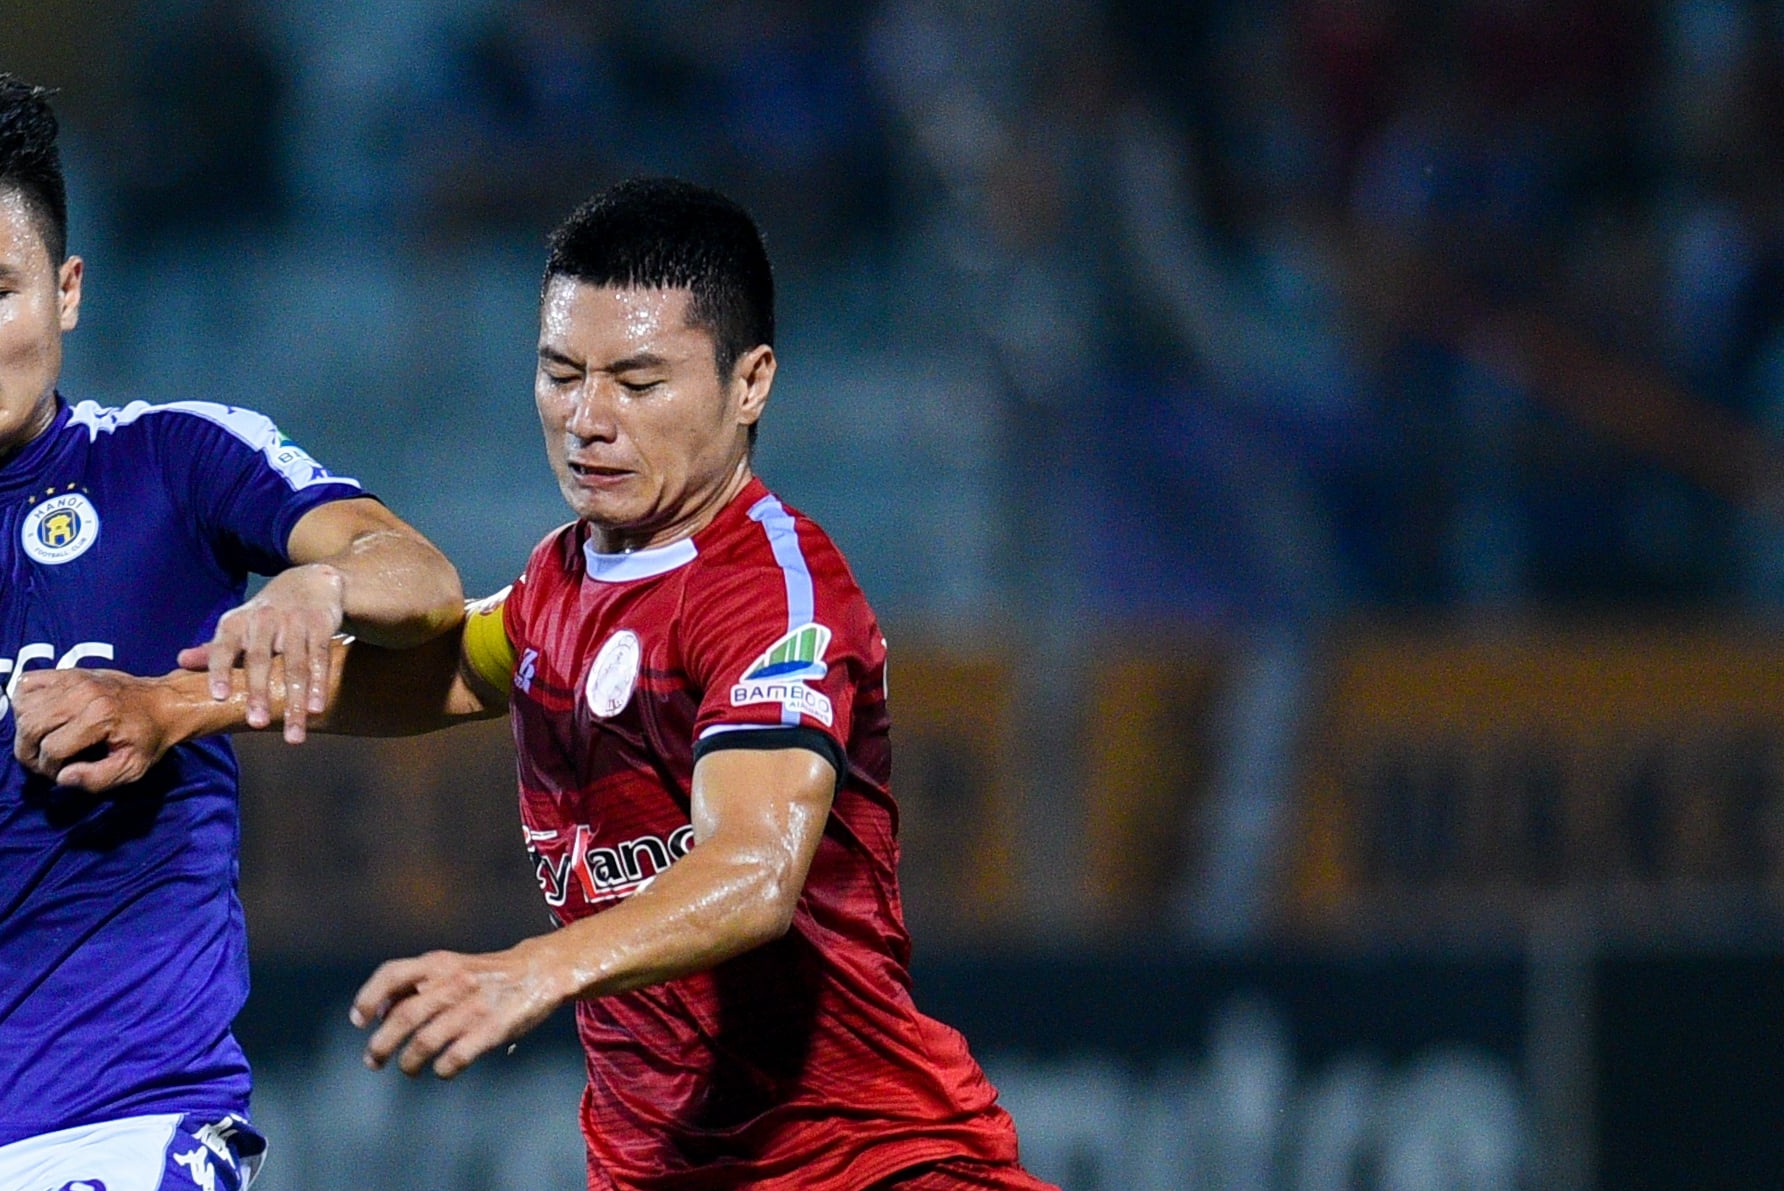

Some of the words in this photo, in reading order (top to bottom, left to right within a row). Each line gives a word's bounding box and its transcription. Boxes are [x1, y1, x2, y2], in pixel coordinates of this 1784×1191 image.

[34, 497, 84, 519] HANOI
[34, 546, 69, 558] FOOTBALL
[734, 685, 830, 714] BAMBOO
